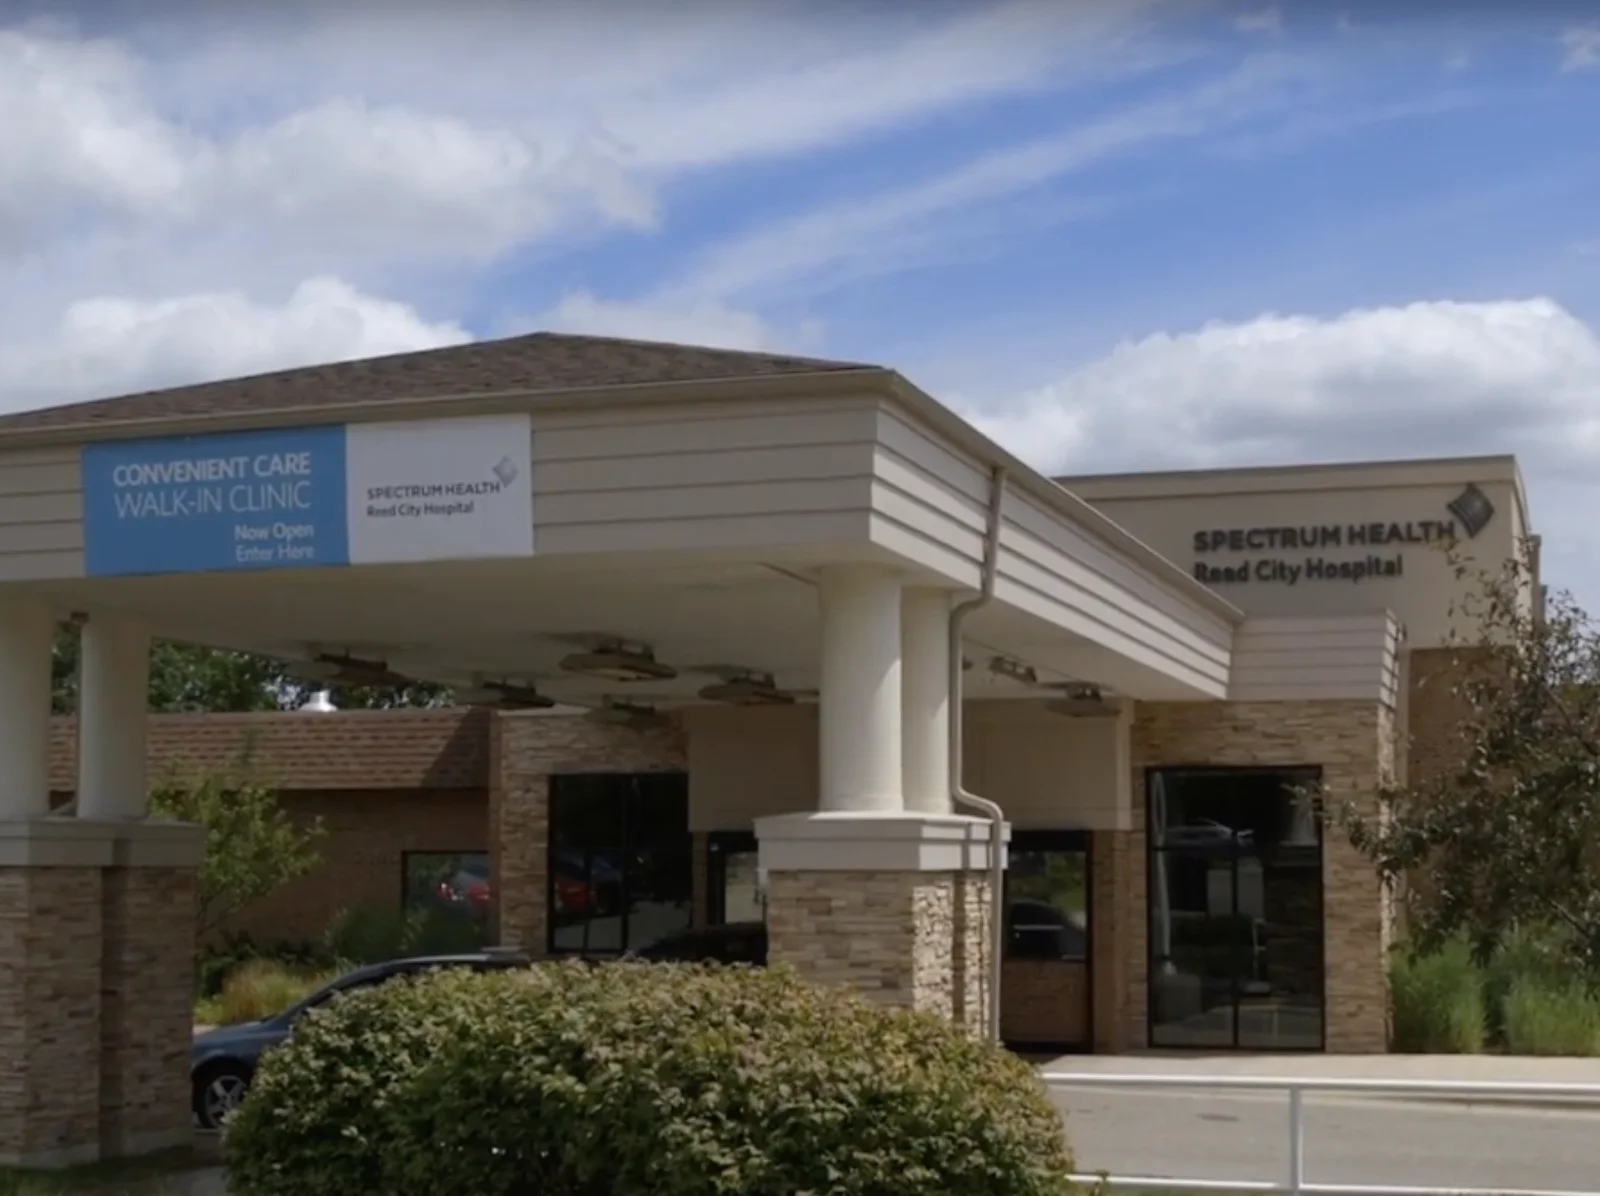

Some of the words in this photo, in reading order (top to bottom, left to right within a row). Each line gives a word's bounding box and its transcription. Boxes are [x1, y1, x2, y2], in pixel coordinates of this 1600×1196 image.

[112, 457, 250, 486] CONVENIENT
[253, 452, 311, 476] CARE
[114, 486, 224, 519] WALK-IN
[230, 480, 311, 513] CLINIC
[366, 483, 443, 501] SPECTRUM
[445, 480, 500, 496] HEALTH
[366, 504, 396, 518] Reed
[398, 503, 422, 519] City
[424, 501, 474, 518] Hospital
[234, 524, 269, 541] Now
[272, 522, 314, 543] Open
[1193, 525, 1341, 552] SPECTRUM
[1348, 520, 1455, 545] HEALTH
[235, 544, 274, 562] Enter
[278, 543, 315, 560] Here
[1194, 560, 1249, 583] Reed
[1255, 559, 1302, 585] City
[1306, 554, 1403, 583] Hospital
